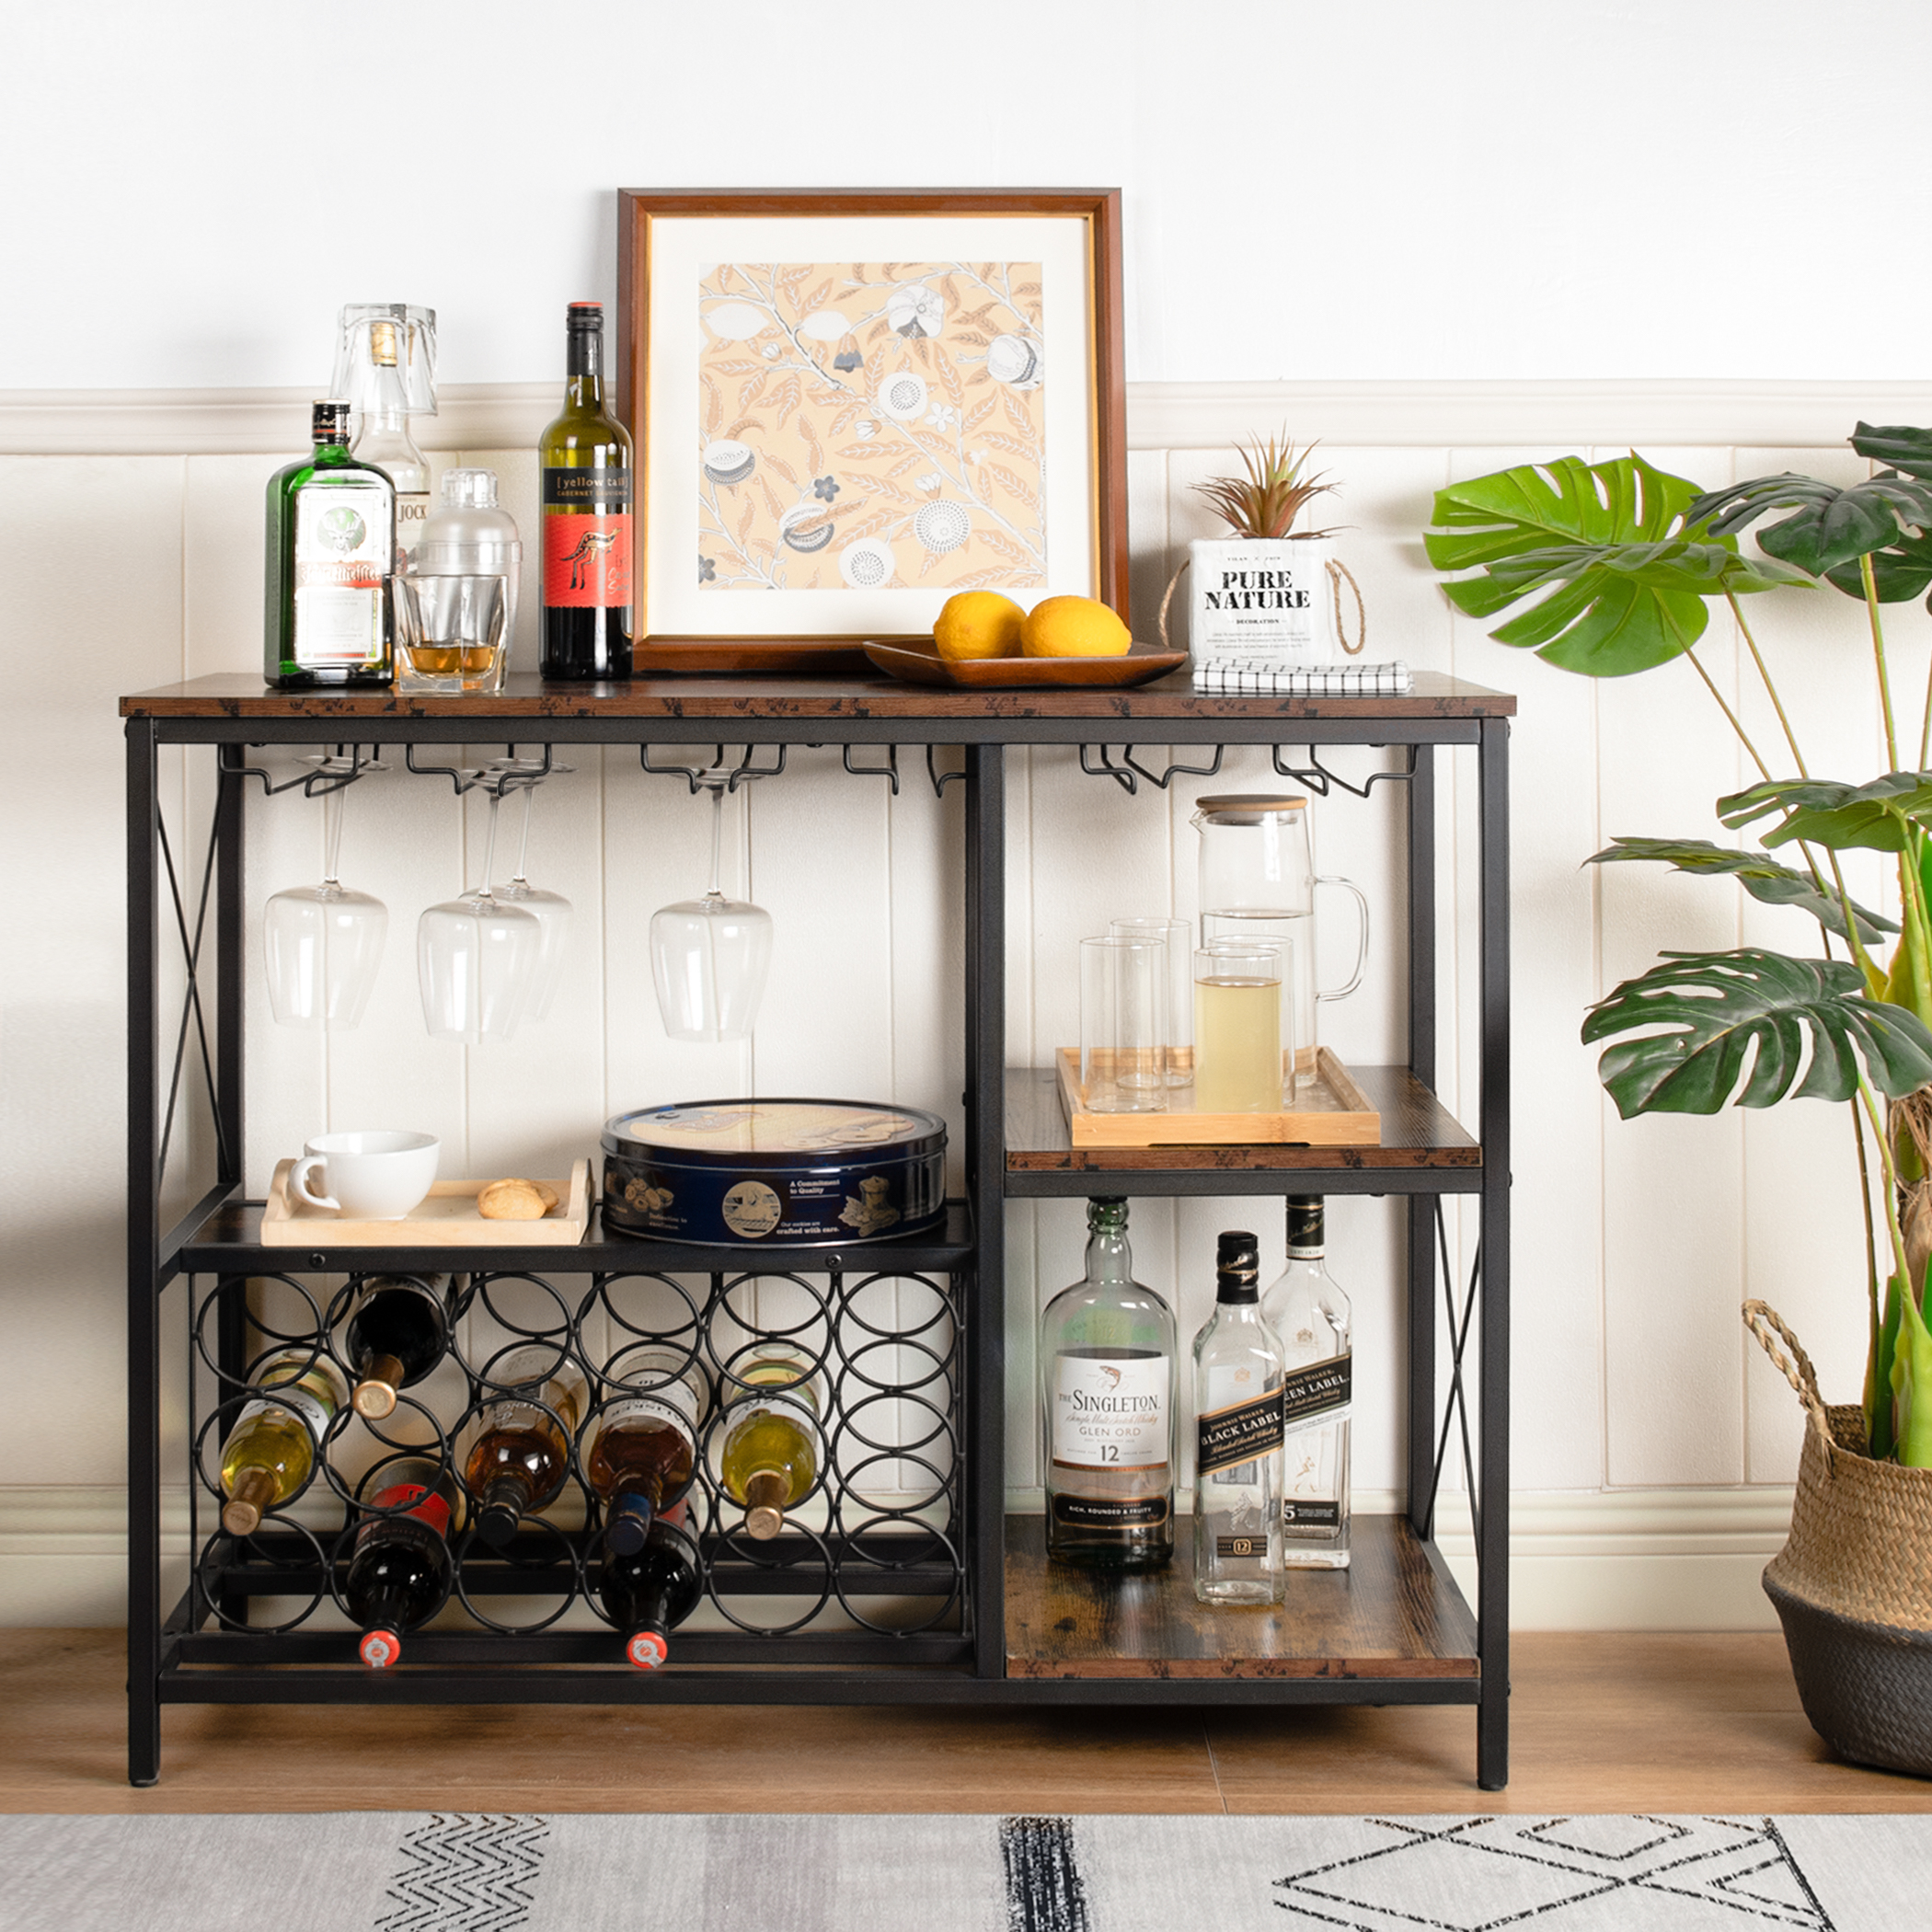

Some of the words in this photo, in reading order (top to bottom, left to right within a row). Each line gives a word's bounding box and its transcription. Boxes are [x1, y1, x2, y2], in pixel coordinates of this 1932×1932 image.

[397, 504, 427, 523] JOCK
[1222, 570, 1293, 590] PURE
[1204, 590, 1311, 611] NATURE
[799, 1187, 824, 1195] Quality
[1284, 1386, 1306, 1401] EEN
[1079, 1427, 1110, 1437] GLEN
[1115, 1427, 1142, 1437] ORD
[1201, 1425, 1241, 1446] BLACK
[1242, 1410, 1282, 1432] LABEL
[1100, 1445, 1120, 1461] 12
[1236, 1542, 1248, 1552] 12
